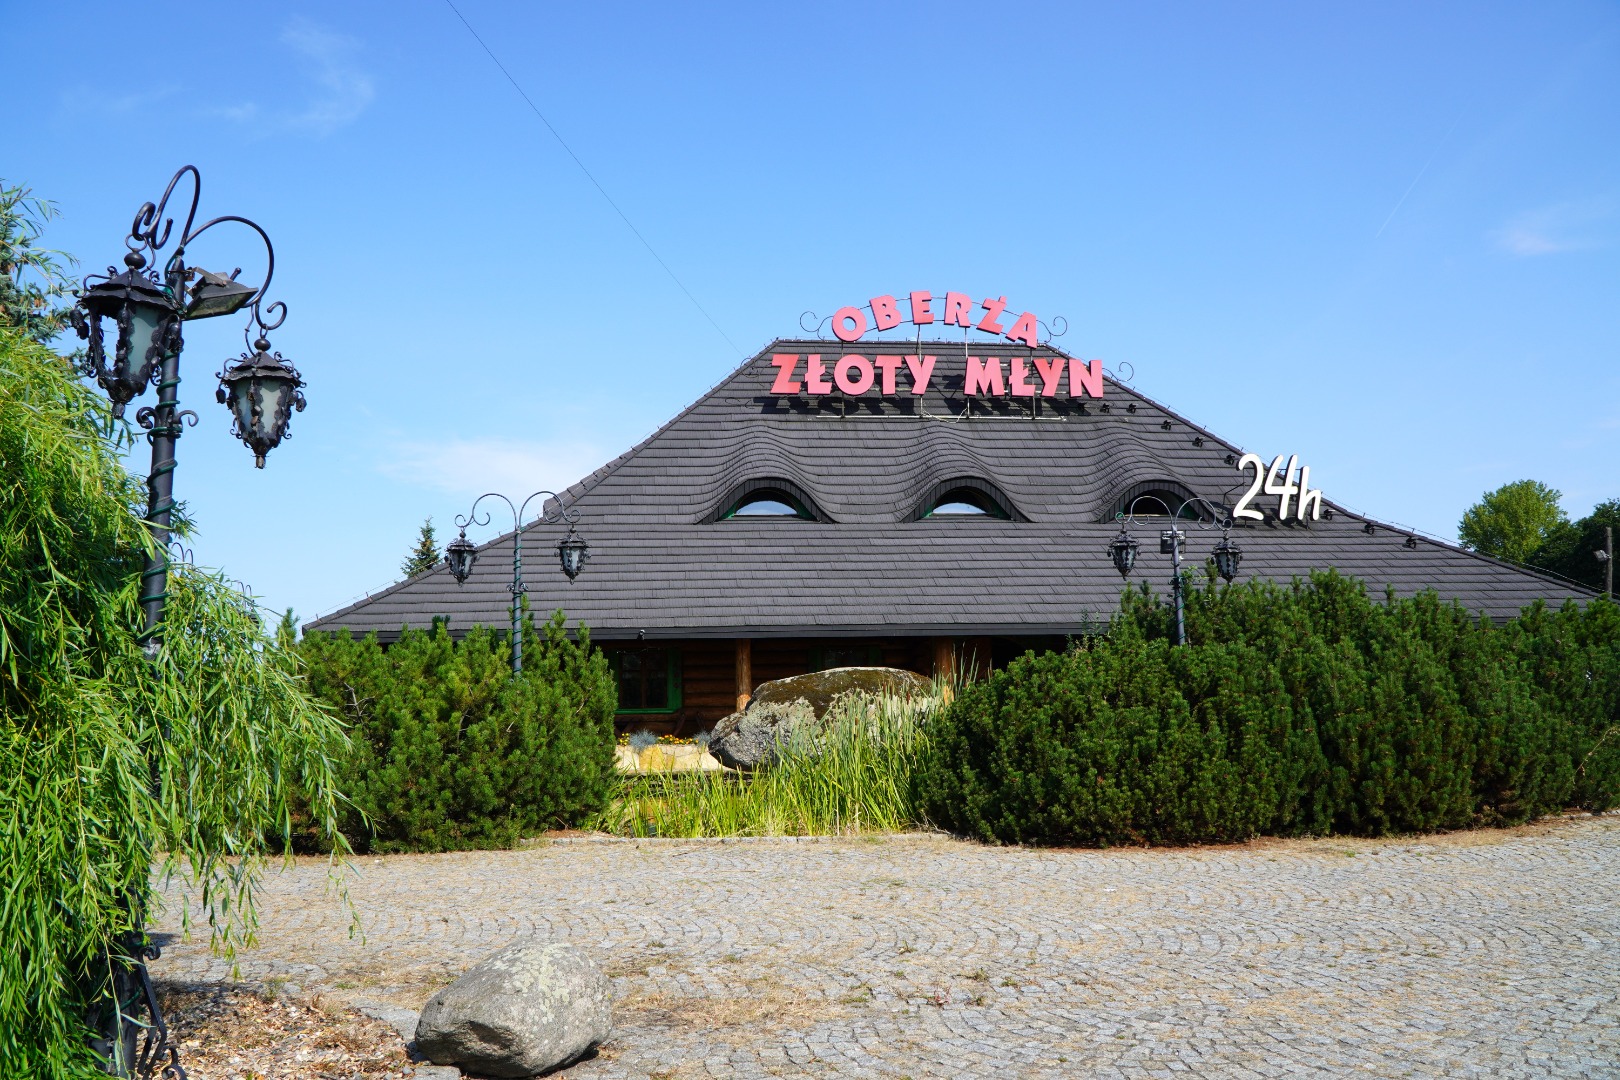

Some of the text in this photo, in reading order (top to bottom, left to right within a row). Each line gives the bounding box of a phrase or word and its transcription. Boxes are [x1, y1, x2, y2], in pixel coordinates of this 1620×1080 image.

[831, 290, 1038, 349] OBERŻA
[770, 353, 1104, 399] ZŁOTY MŁYN
[1233, 453, 1322, 521] 24h
